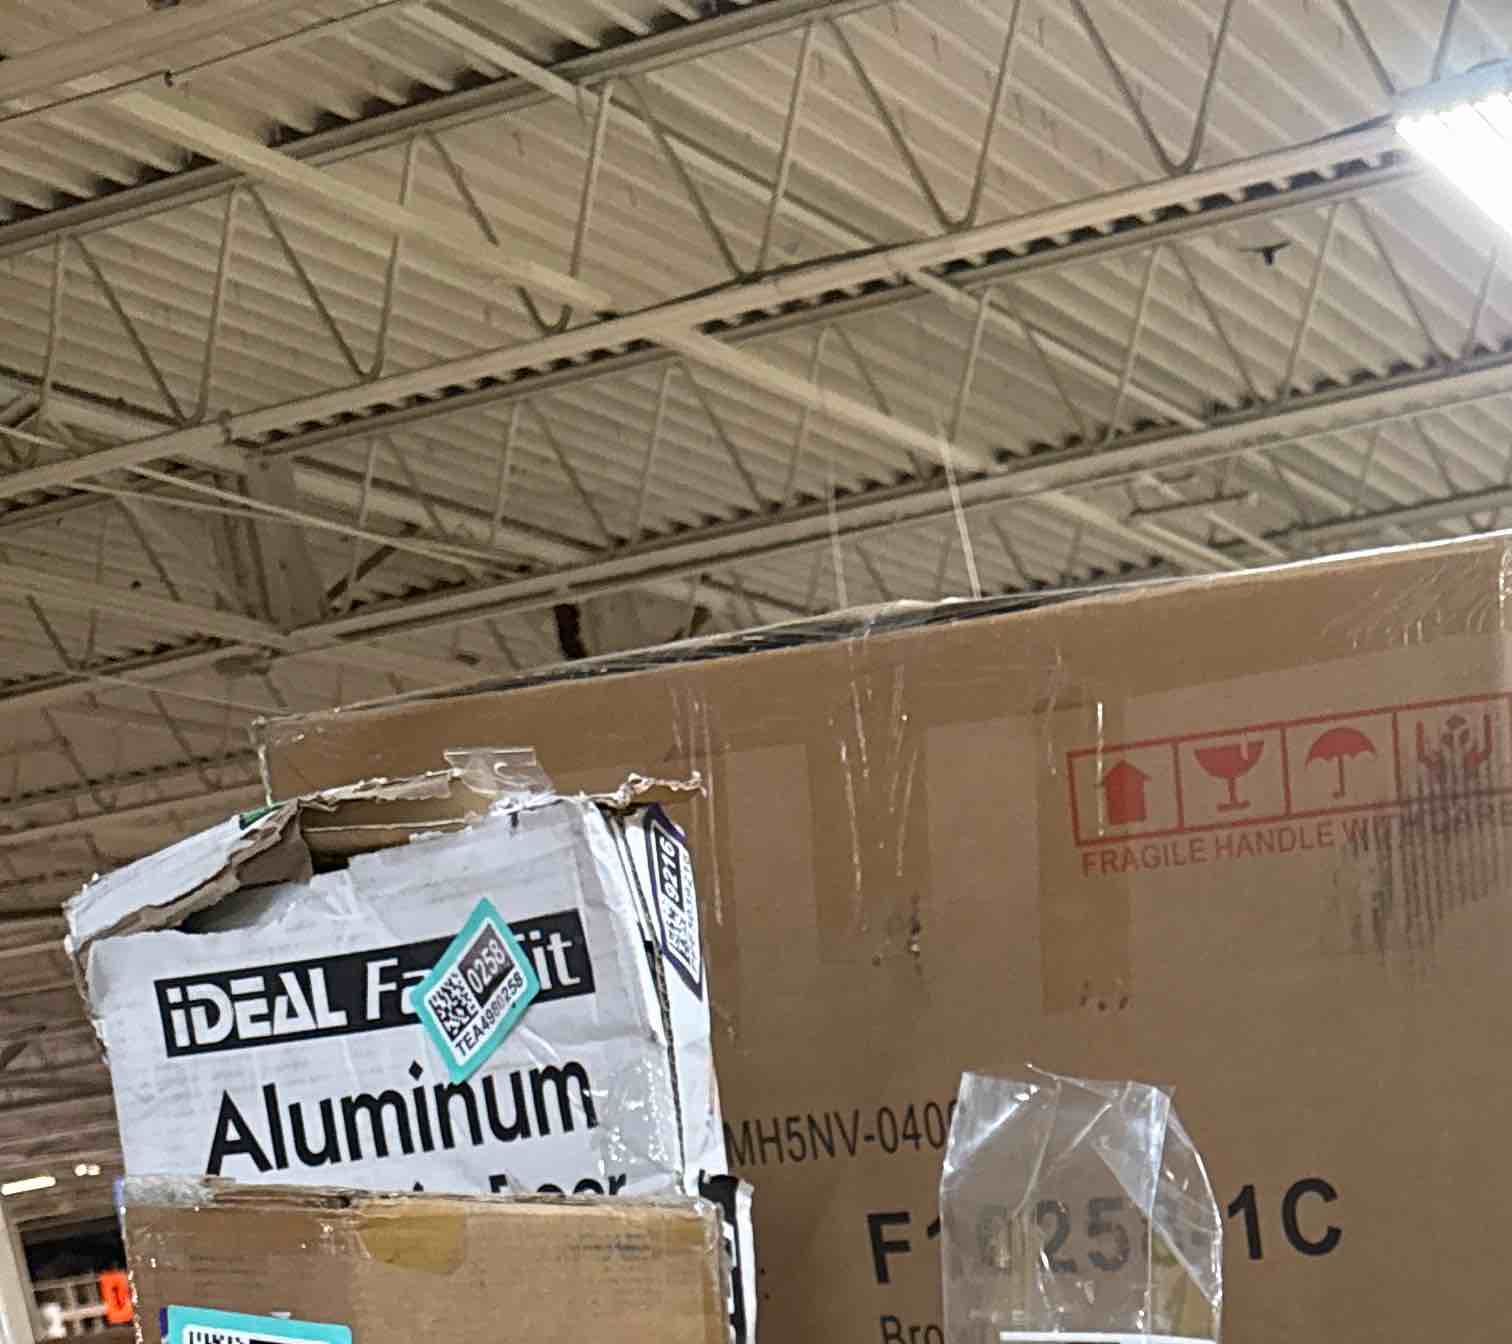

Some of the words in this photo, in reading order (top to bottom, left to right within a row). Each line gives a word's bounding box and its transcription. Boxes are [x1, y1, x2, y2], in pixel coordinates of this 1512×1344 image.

[1080, 838, 1208, 878] FRAGILE
[1213, 819, 1335, 859] HANDLE
[469, 939, 507, 995] 0258
[206, 1059, 601, 1176] Aluminum
